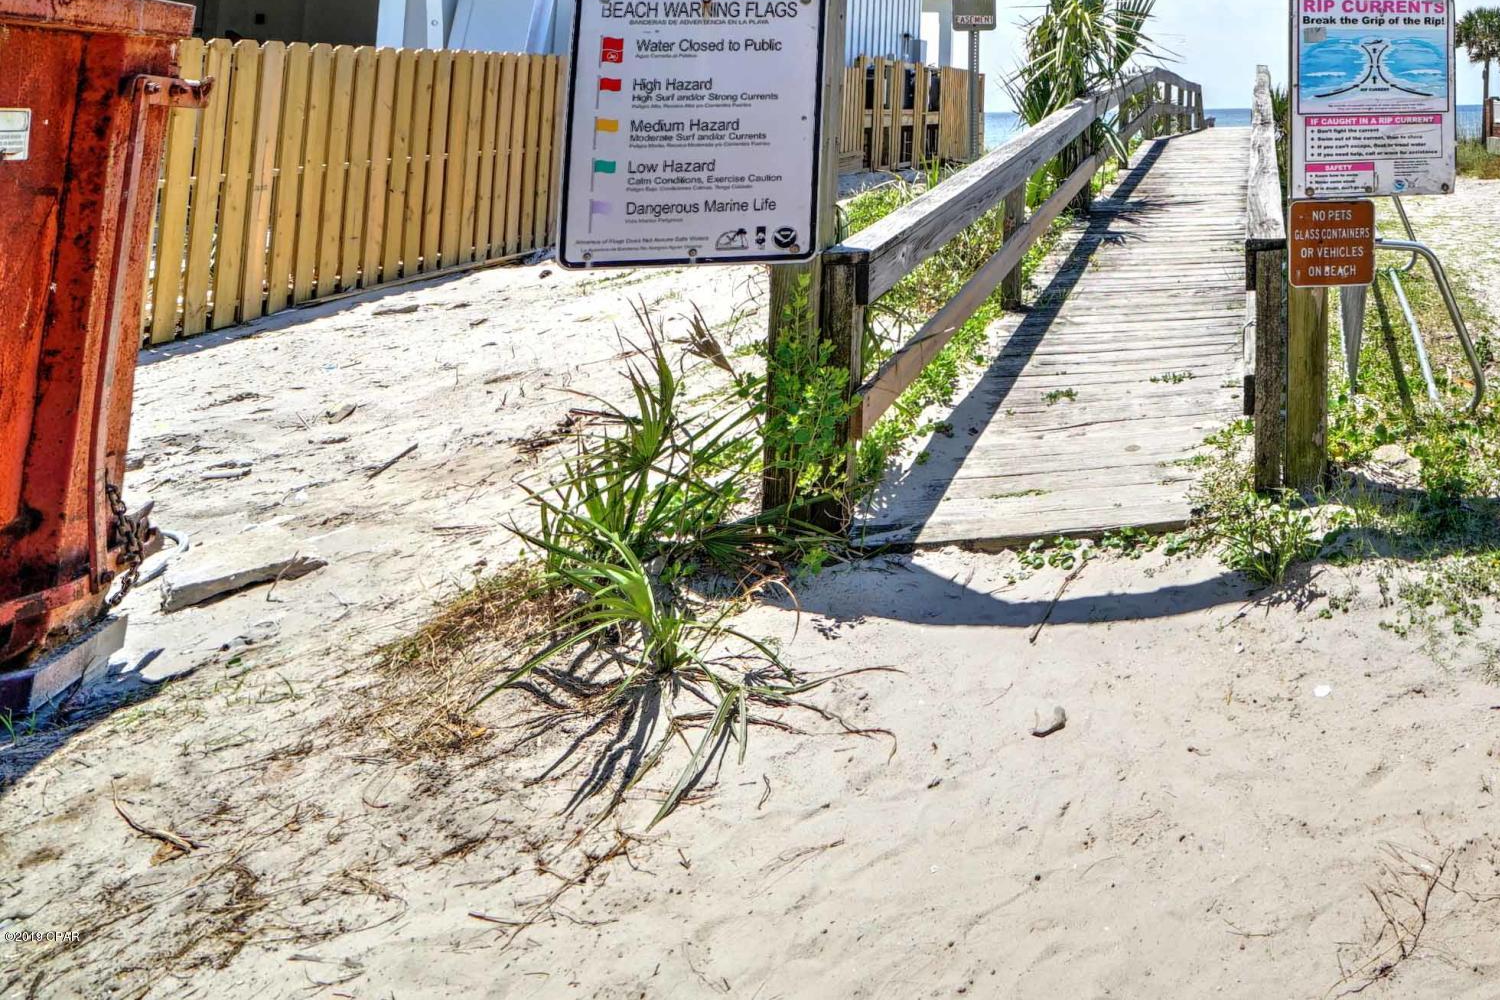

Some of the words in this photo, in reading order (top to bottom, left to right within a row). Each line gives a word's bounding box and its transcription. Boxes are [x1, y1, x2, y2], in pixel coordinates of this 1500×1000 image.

[601, 2, 658, 18] BEACH
[663, 1, 740, 18] WARNING
[745, 1, 798, 18] FLAGS
[1303, 0, 1335, 13] RIP
[1341, 0, 1445, 14] CURRENTS
[1302, 16, 1337, 25] Break
[1340, 16, 1359, 25] the
[1362, 16, 1385, 26] Grip
[1388, 16, 1401, 25] of
[1403, 17, 1421, 25] the
[1424, 17, 1445, 27] Rip!
[636, 39, 676, 52] Water
[679, 38, 724, 52] Closed
[729, 38, 740, 51] to
[745, 38, 782, 51] Public
[633, 78, 661, 94] High
[666, 77, 713, 91] Hazard
[632, 93, 652, 103] High
[655, 92, 675, 102] Surf
[677, 92, 705, 101] and/or
[708, 92, 738, 103] Strong
[740, 92, 778, 101] Currents
[631, 118, 685, 133] Medium
[690, 118, 740, 131] Hazard
[630, 133, 673, 142] Moderate
[676, 133, 696, 141] Surf
[697, 132, 726, 141] and/or
[728, 131, 767, 141] Currents
[628, 160, 658, 174] Low
[663, 159, 716, 173] Hazard
[627, 176, 652, 186] Calm
[706, 175, 745, 184] Exercise
[748, 174, 782, 182] Caution
[626, 201, 700, 218] Dangerous
[704, 199, 749, 213] Marine
[753, 198, 777, 211] Life
[1312, 210, 1326, 221] NO
[1328, 209, 1352, 220] PETS
[1294, 228, 1320, 240] GLASS
[1321, 227, 1370, 240] CONTAINERS
[1300, 247, 1314, 258] OR
[1317, 246, 1364, 258] VEHICLES
[1308, 265, 1322, 277] ON
[1323, 264, 1357, 277] BEACH
